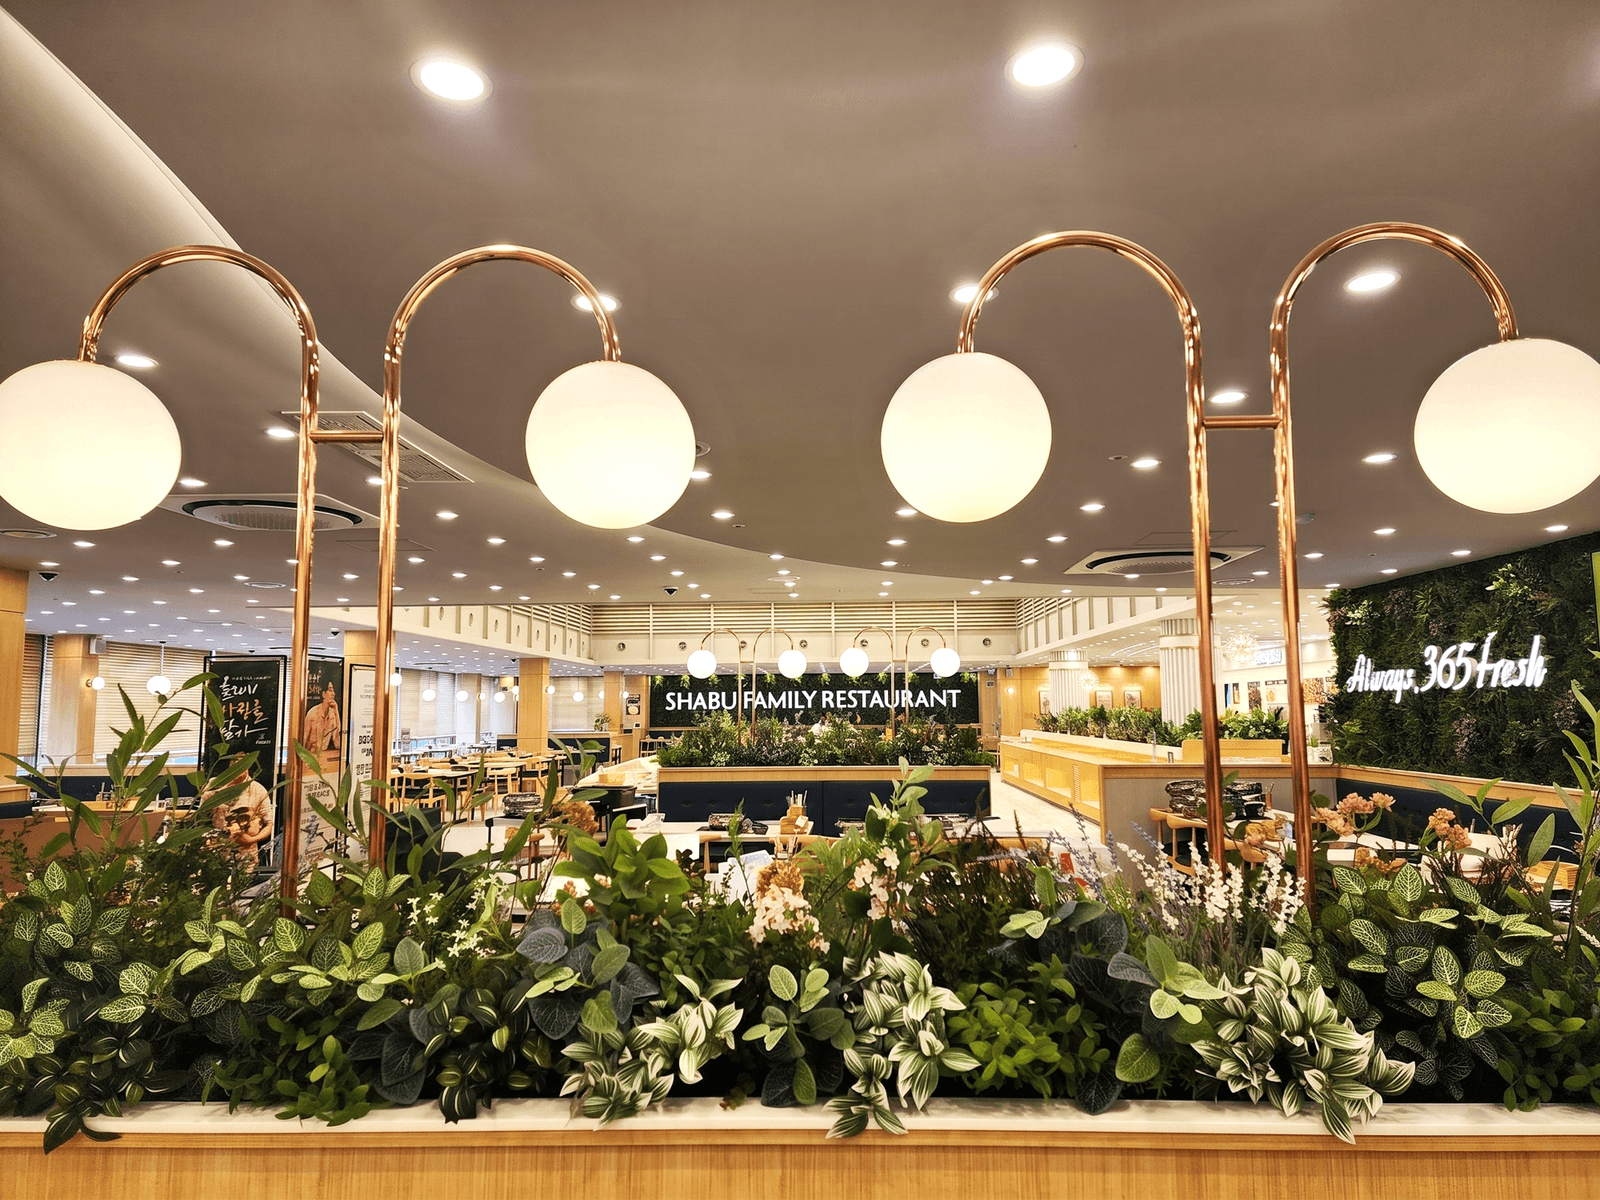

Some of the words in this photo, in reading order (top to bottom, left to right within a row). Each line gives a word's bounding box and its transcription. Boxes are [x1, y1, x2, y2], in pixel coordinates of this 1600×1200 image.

[1420, 642, 1477, 692] 365
[665, 691, 737, 711] SHABU
[743, 690, 817, 710] FAMILY
[821, 689, 962, 709] RESTAURANT
